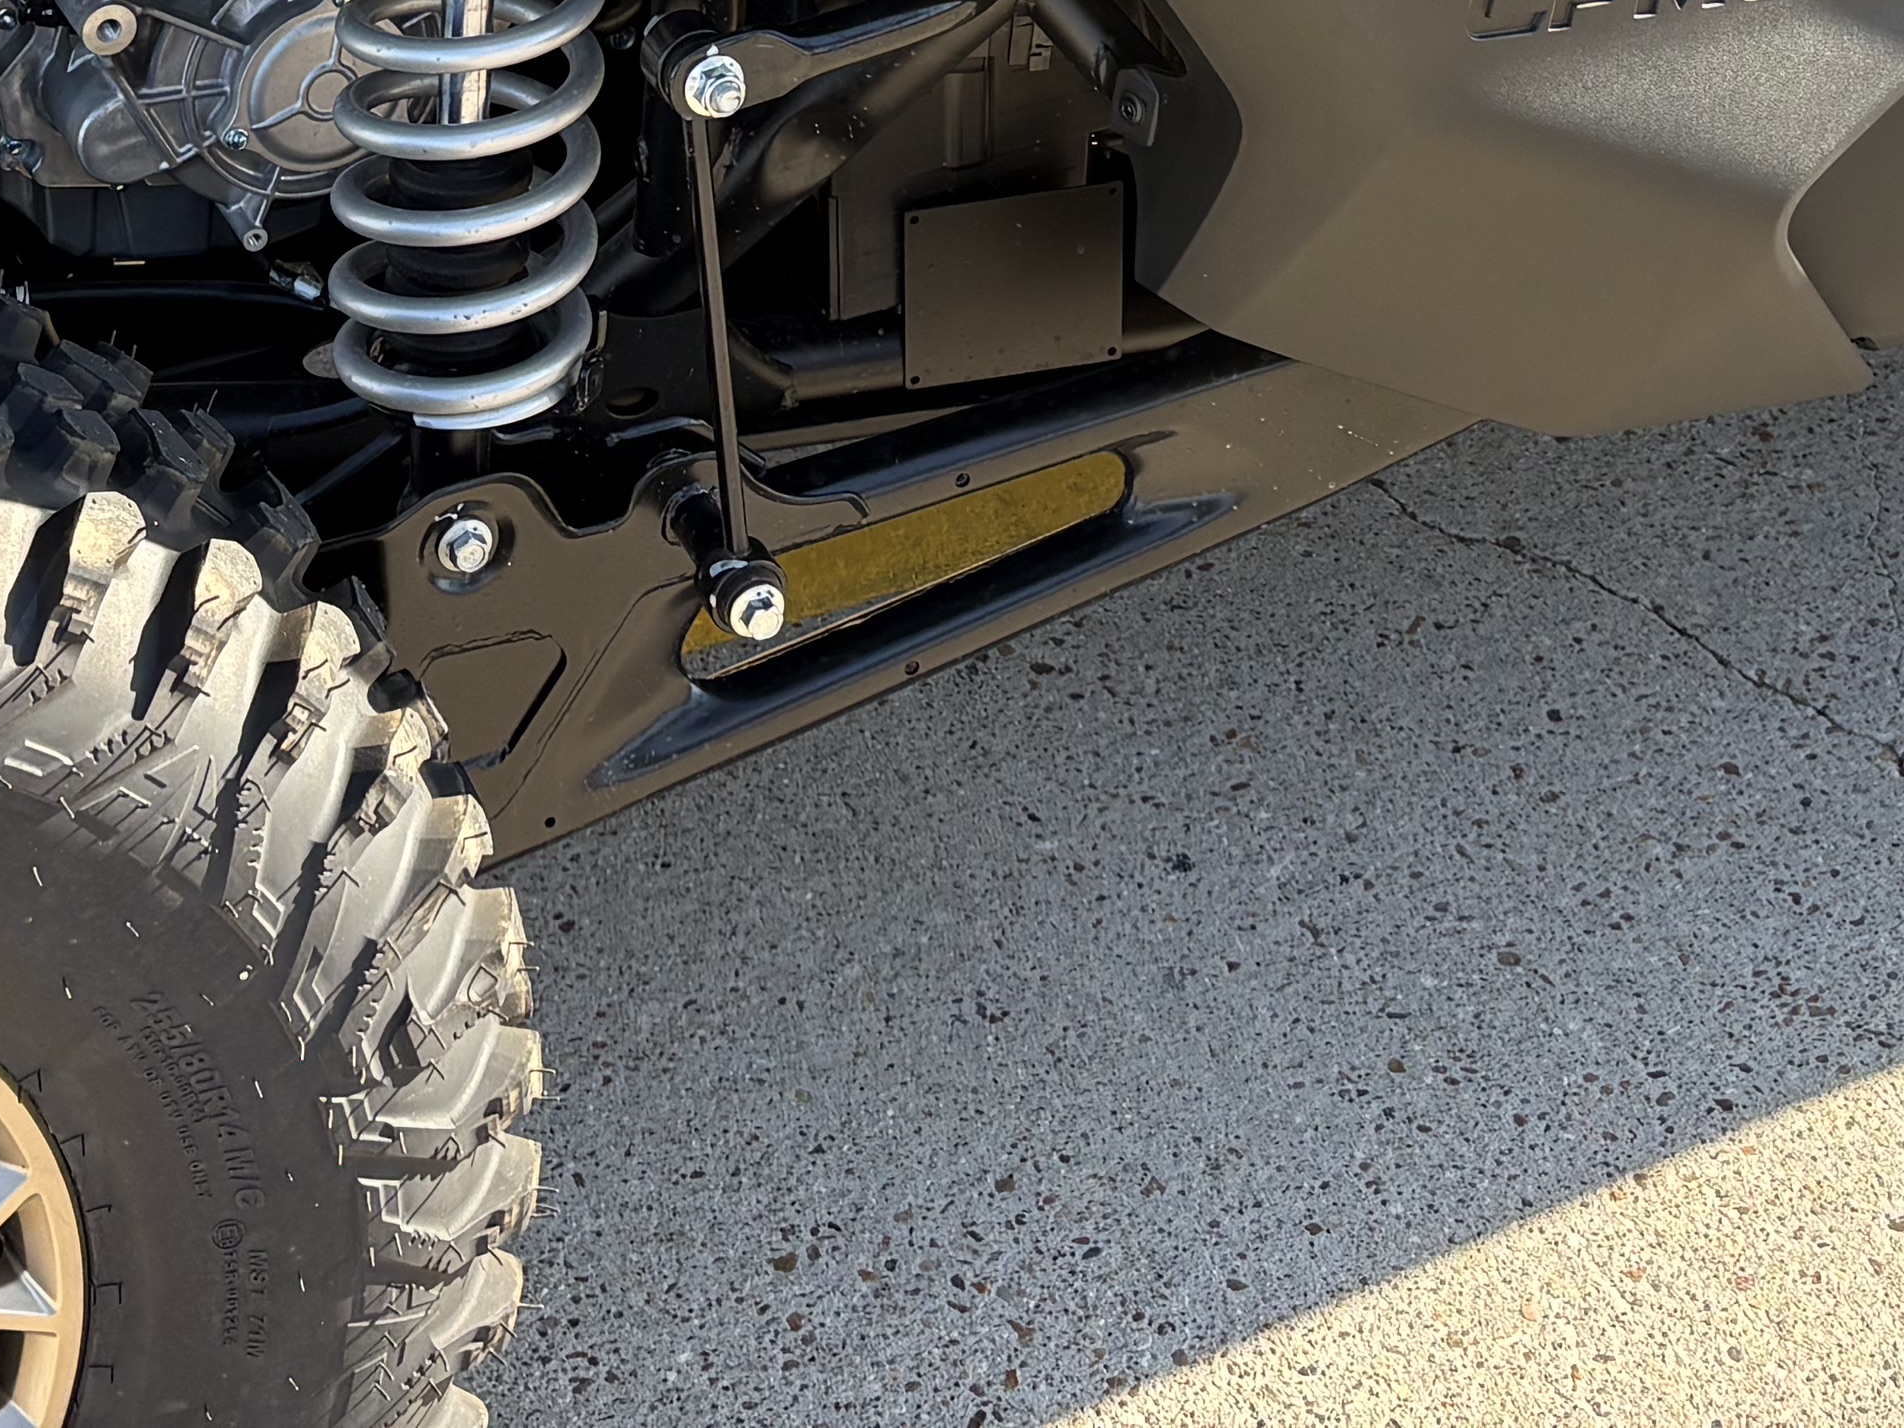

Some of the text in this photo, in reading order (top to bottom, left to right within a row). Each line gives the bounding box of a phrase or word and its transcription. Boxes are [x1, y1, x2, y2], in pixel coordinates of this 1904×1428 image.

[130, 990, 267, 1209] 255/80R14 M/C
[158, 1089, 185, 1120] UTV
[175, 1124, 197, 1155] USE
[188, 1159, 213, 1197] ONLY
